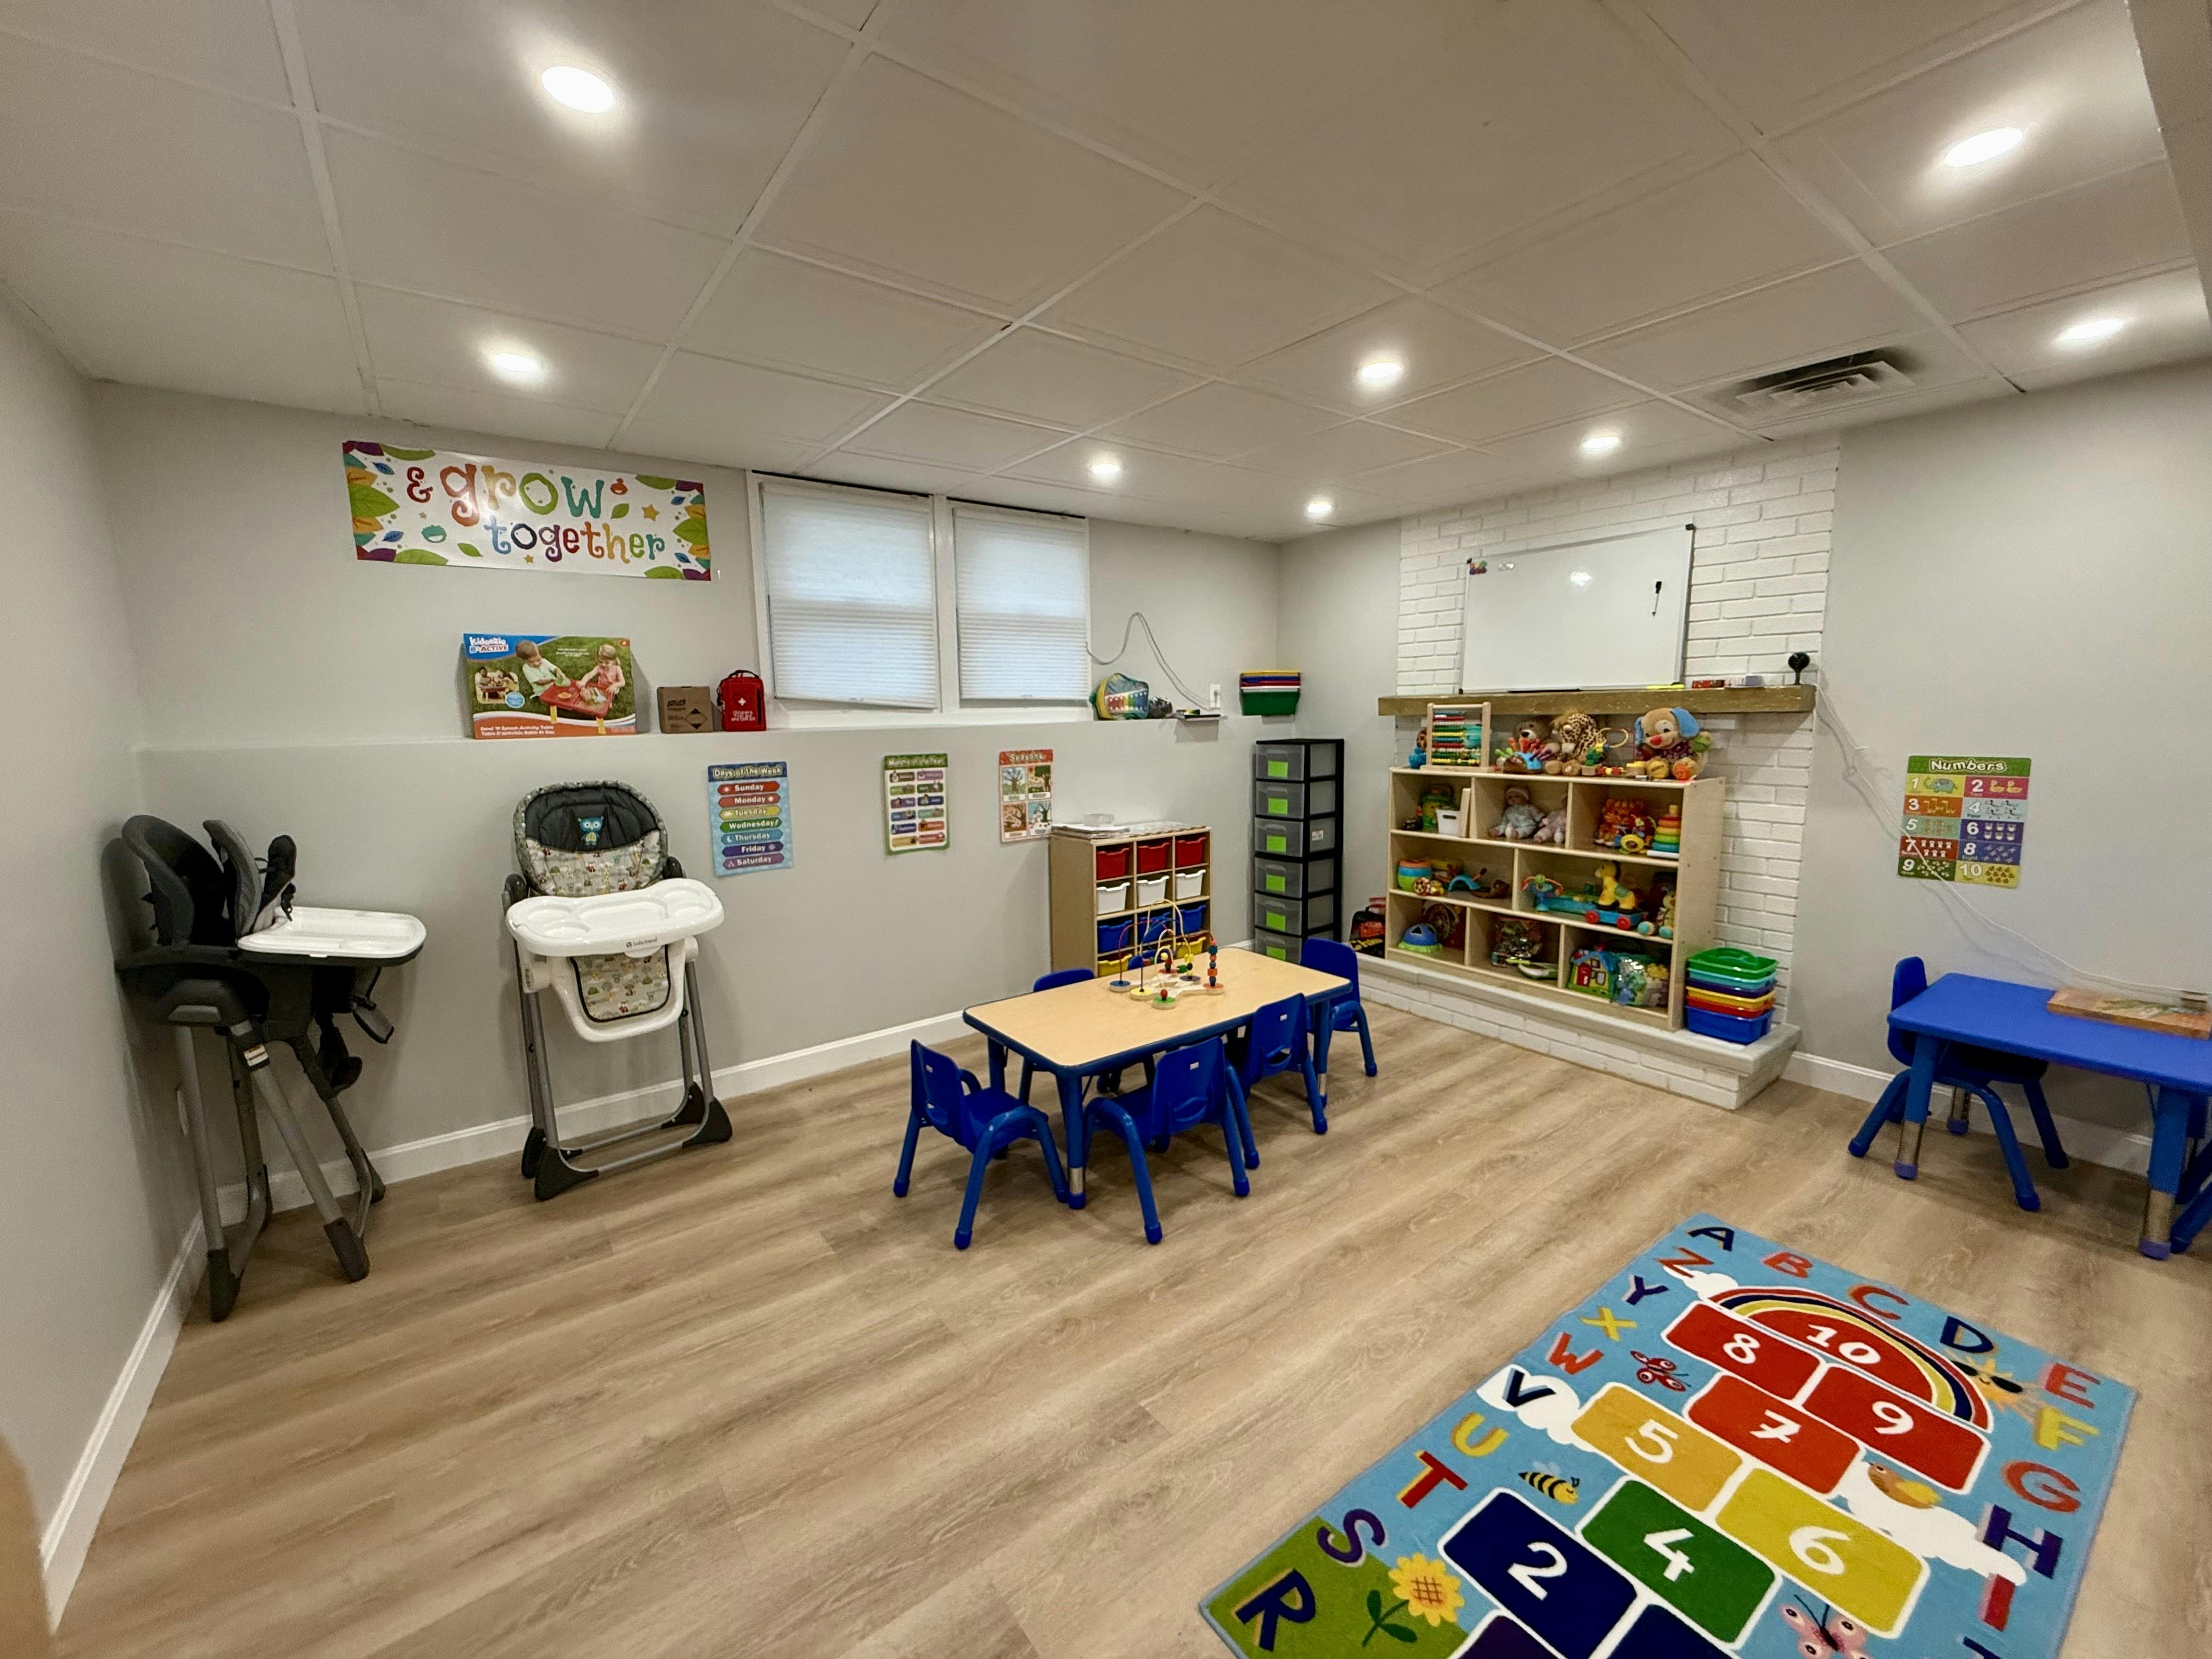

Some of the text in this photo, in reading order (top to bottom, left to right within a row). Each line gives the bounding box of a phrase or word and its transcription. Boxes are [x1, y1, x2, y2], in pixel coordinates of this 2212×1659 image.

[407, 463, 604, 526] & grow
[484, 515, 664, 563] together
[715, 769, 732, 778] Days
[736, 768, 743, 777] of
[1931, 760, 2005, 771] Numbers
[735, 784, 765, 792] Sunday
[1911, 778, 1918, 789] 1
[1971, 779, 1984, 792] 2
[735, 808, 767, 816] Tuesday
[1908, 798, 1920, 810] 3
[1968, 802, 1980, 813] 4
[729, 820, 775, 830] Wednesday
[735, 832, 771, 842] Thursday
[1906, 819, 1918, 831] 5
[1967, 822, 1979, 835] 6
[737, 856, 772, 865] Saturday
[741, 844, 766, 853] Friday
[1905, 839, 1916, 851] 7
[1963, 842, 1977, 855] 8
[1902, 859, 1915, 871] 9
[1959, 864, 1982, 877] 10
[1688, 1227, 1735, 1251] A
[1655, 1247, 1714, 1278] Z
[1762, 1251, 1813, 1278] B
[1622, 1274, 1669, 1306] Y
[1848, 1284, 1910, 1321] C
[1580, 1306, 1637, 1342] X
[1940, 1316, 1995, 1353] D
[1546, 1332, 1604, 1375] W
[1723, 1333, 1760, 1364] 8
[1805, 1323, 1881, 1364] 10
[1502, 1369, 1556, 1408] V
[2040, 1362, 2101, 1409] E
[1749, 1409, 1802, 1443] 7
[1872, 1401, 1914, 1435] 9
[2034, 1406, 2101, 1451] F
[1451, 1412, 1510, 1458] U
[1624, 1419, 1679, 1464] 5
[1396, 1450, 1469, 1509] T
[2001, 1459, 2081, 1514] G
[1317, 1508, 1389, 1568] S
[1643, 1527, 1695, 1582] 4
[1788, 1525, 1852, 1575] 6
[1977, 1502, 2063, 1579] H
[1506, 1541, 1567, 1601] 2
[1231, 1567, 1317, 1652] R
[1978, 1573, 2016, 1632] I
